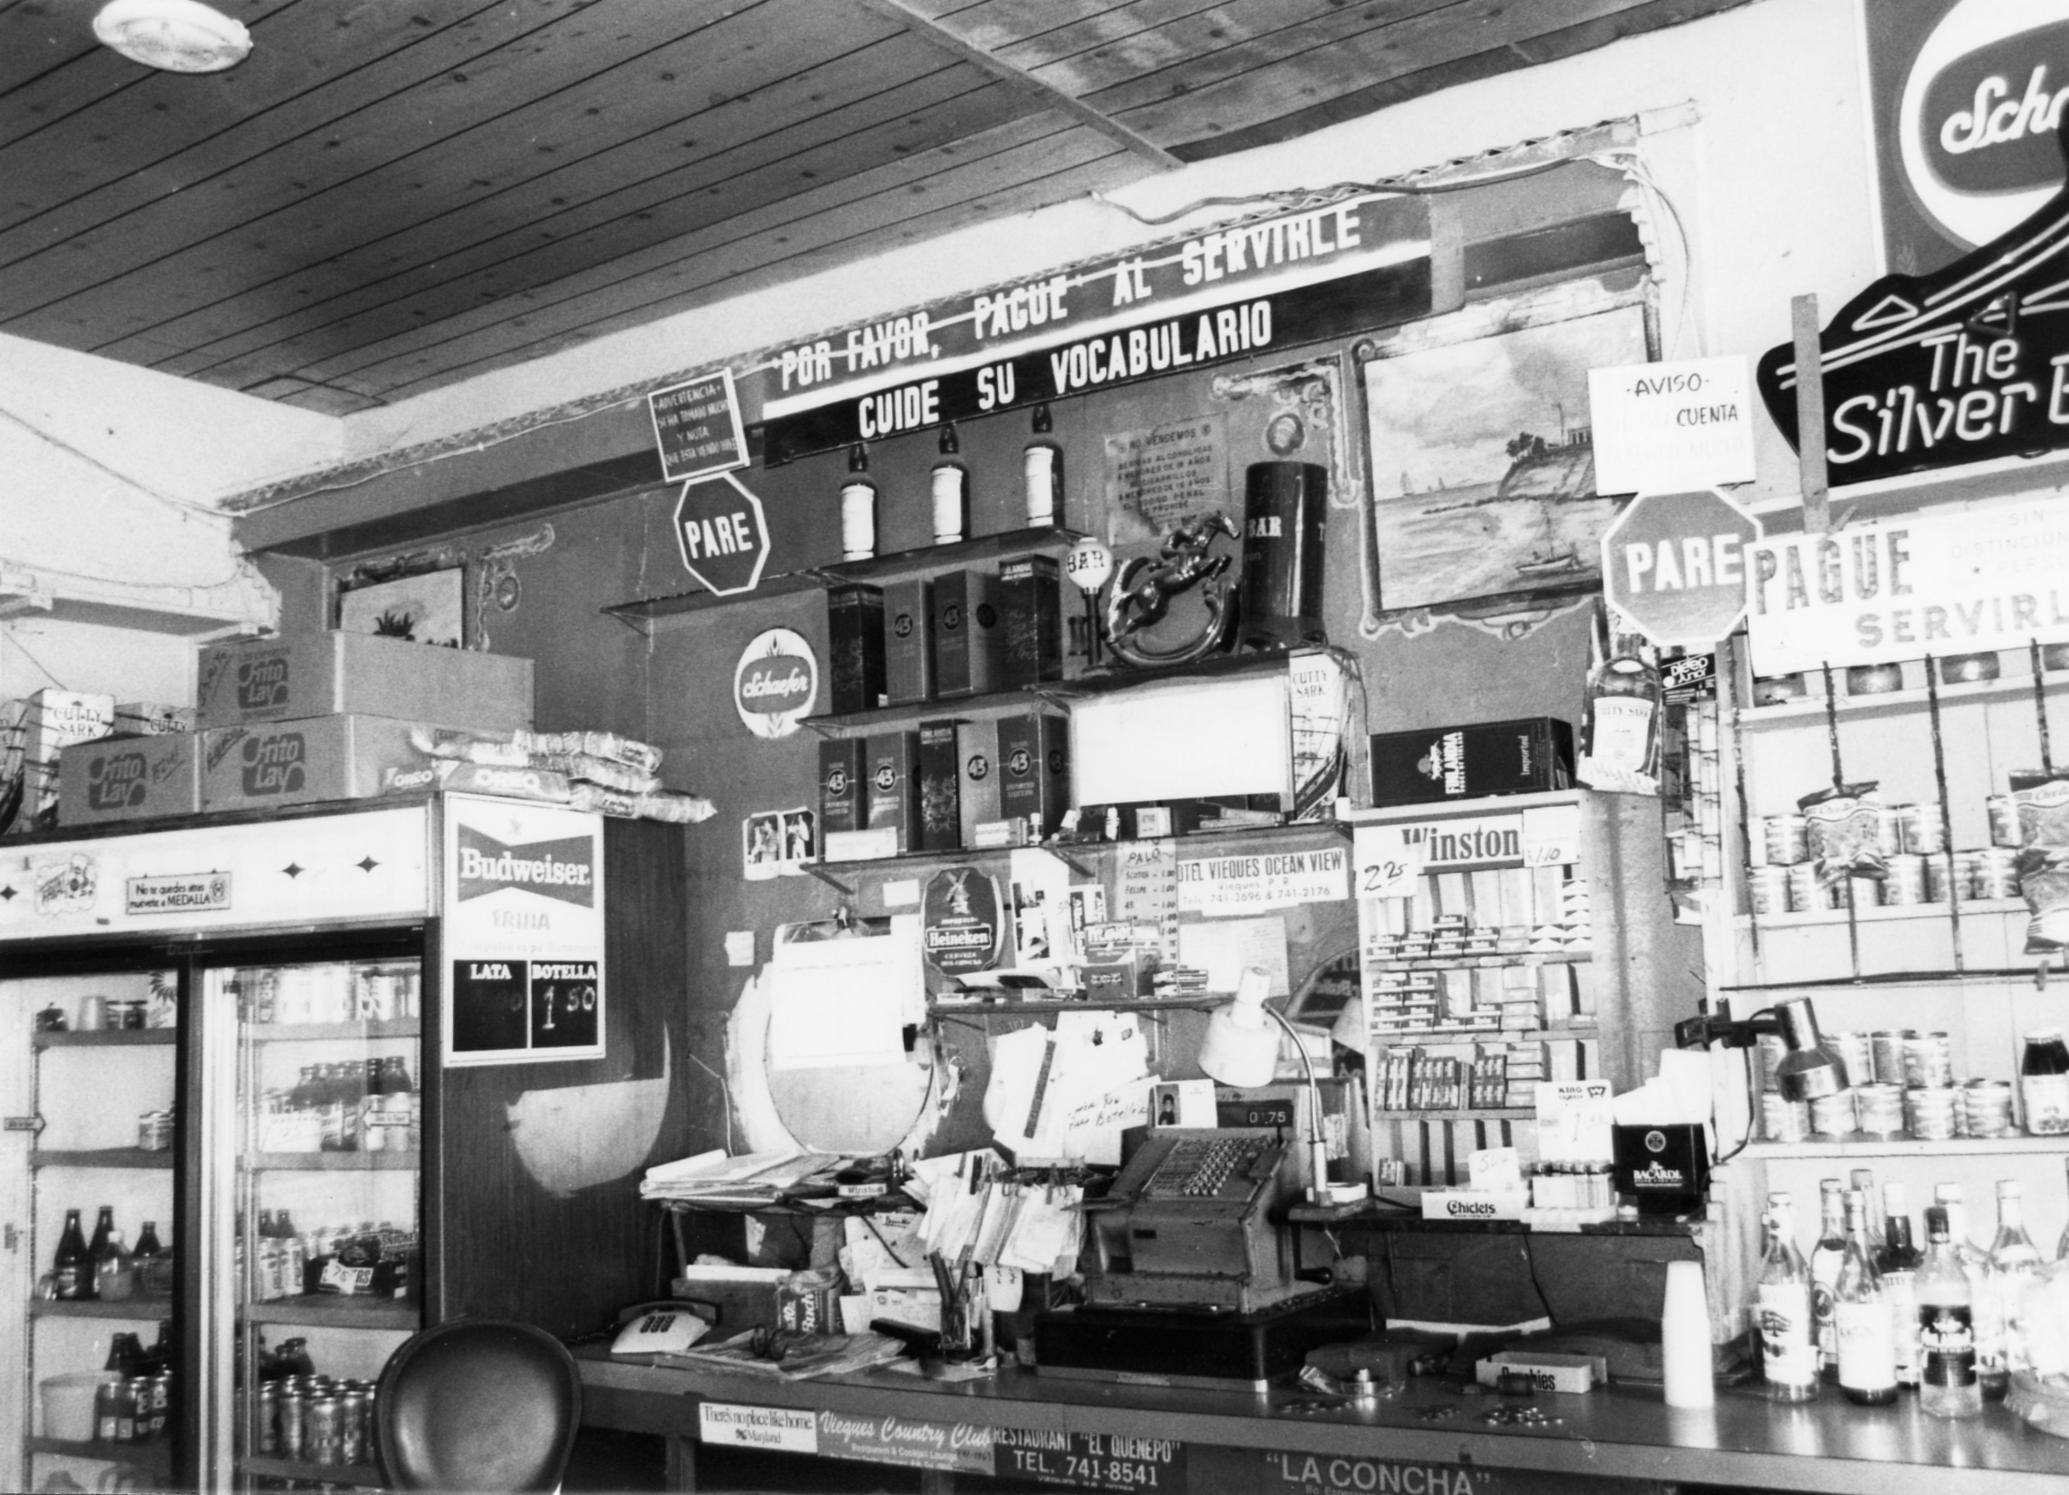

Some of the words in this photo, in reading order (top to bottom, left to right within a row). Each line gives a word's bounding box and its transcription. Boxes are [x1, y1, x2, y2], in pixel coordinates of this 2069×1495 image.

[781, 341, 831, 391] POR
[848, 312, 940, 371] FAVOR,
[974, 275, 1068, 340] PAGUE
[1114, 258, 1151, 306] AL
[1182, 202, 1361, 286] SERVIRLE
[858, 380, 940, 438] CUIDE
[977, 362, 1016, 410] SU
[1051, 300, 1272, 394] VOCABULARIO
[1922, 333, 2020, 392] The
[1676, 404, 1739, 428] CUENTA
[1827, 383, 1997, 464] Silver
[1146, 428, 1197, 446] VENDEMOS
[684, 512, 753, 559] PARE
[1067, 551, 1106, 573] BAR
[1626, 534, 1743, 594] PARE
[1754, 529, 1914, 615] PAGUE
[743, 667, 808, 697] Schaefer
[970, 758, 986, 776] 43
[1011, 753, 1028, 771] 43
[1518, 735, 1531, 776] Imported
[475, 768, 541, 791] OREO
[829, 774, 844, 790] 43
[877, 769, 893, 786] 43
[1178, 862, 1204, 882] OTEL
[1209, 858, 1260, 880] VIEQUES
[1265, 854, 1305, 876] OCEAN
[1309, 851, 1342, 872] VIEW
[136, 884, 148, 895] No
[167, 892, 210, 906] MEDALLA
[929, 929, 989, 947] Heineken
[472, 964, 511, 980] LATA
[532, 964, 597, 980] BOTELLA
[1446, 1199, 1497, 1217] Chiclets
[785, 1411, 814, 1431] home
[819, 1409, 876, 1444] Vieques
[881, 1415, 945, 1449] Country
[950, 1421, 991, 1449] Club
[994, 1427, 1071, 1452] RESTAURANT
[1013, 1450, 1055, 1474] TEL.
[1066, 1455, 1158, 1486] 741-8541
